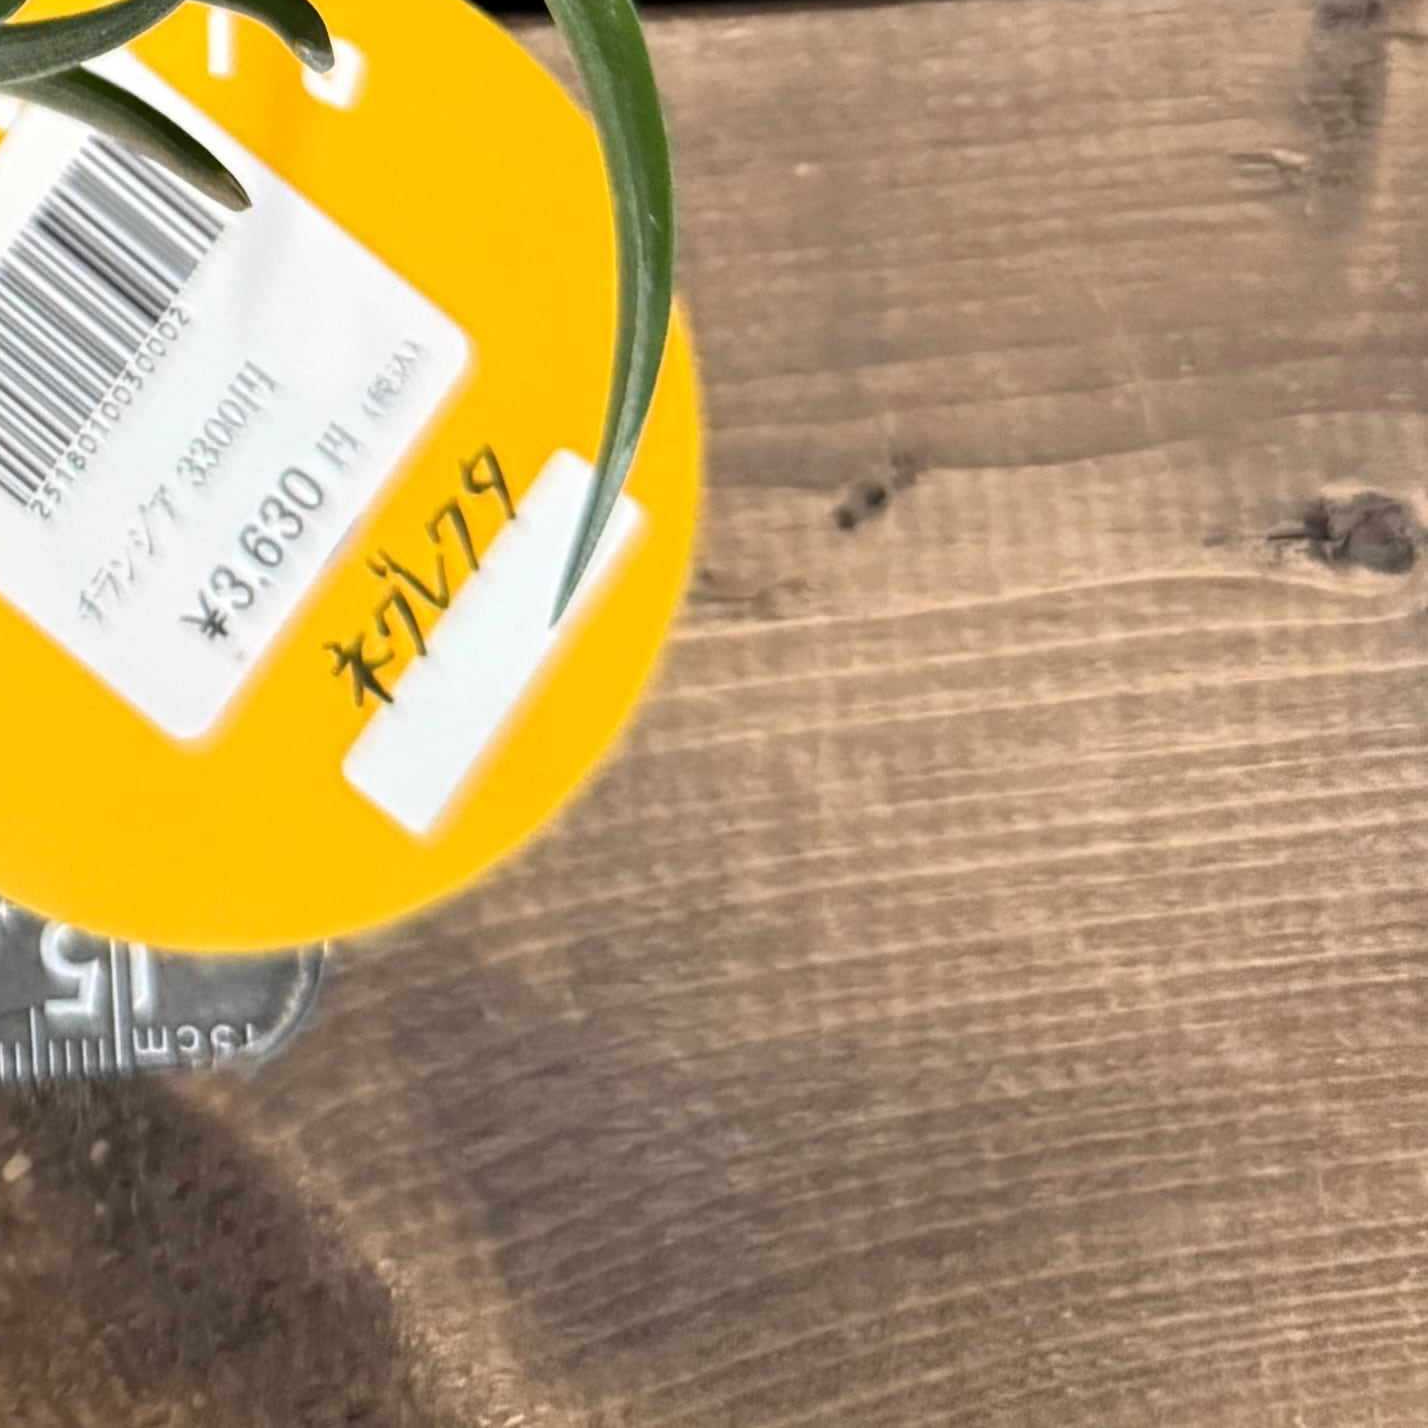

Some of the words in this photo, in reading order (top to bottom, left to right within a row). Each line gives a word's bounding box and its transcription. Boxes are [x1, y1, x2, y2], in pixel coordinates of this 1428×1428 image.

[27, 305, 192, 519] 2518010030002
[76, 485, 182, 627] チランジア
[175, 359, 282, 488] 3300円
[180, 465, 326, 641] ¥3,630
[39, 920, 153, 1018] 15
